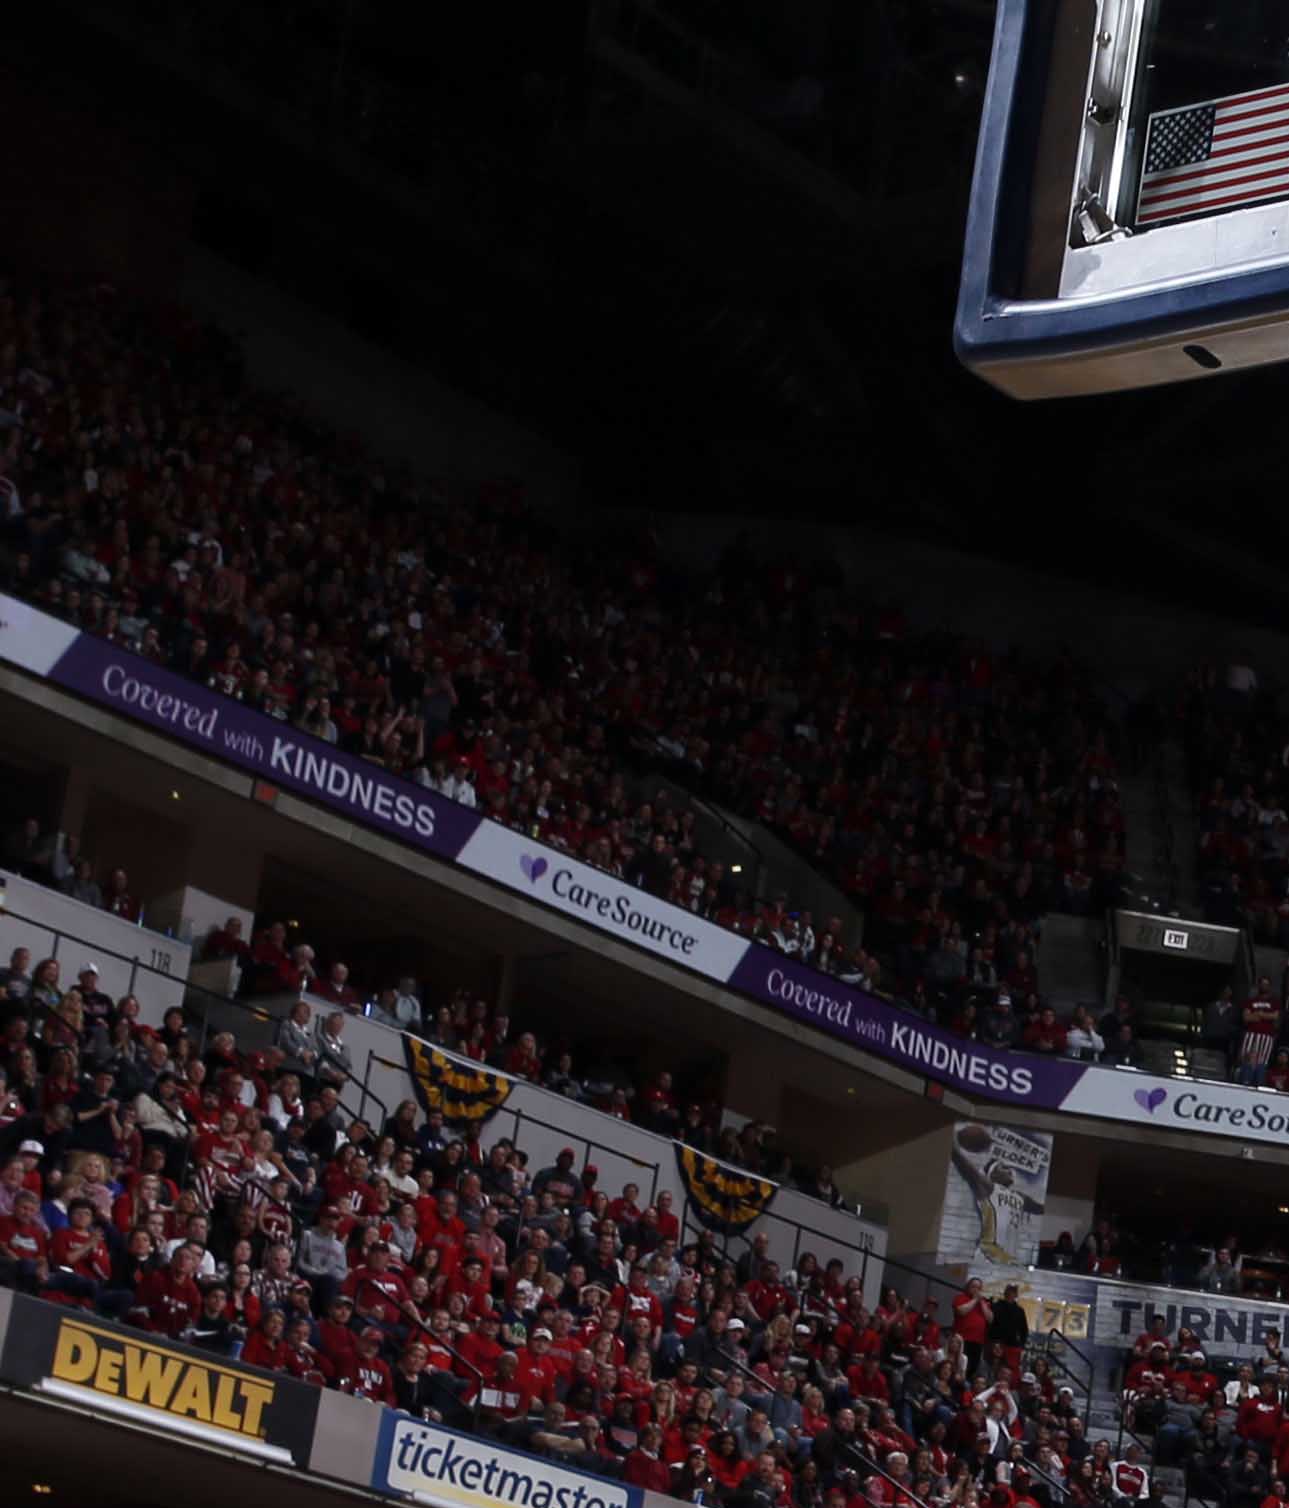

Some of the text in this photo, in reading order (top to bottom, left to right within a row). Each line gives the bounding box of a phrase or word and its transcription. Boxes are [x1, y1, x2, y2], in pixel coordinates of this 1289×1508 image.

[102, 664, 436, 837] Covered with KINDNESS
[552, 869, 699, 955] CareSource
[767, 969, 1033, 1096] Covered with KINDNESS
